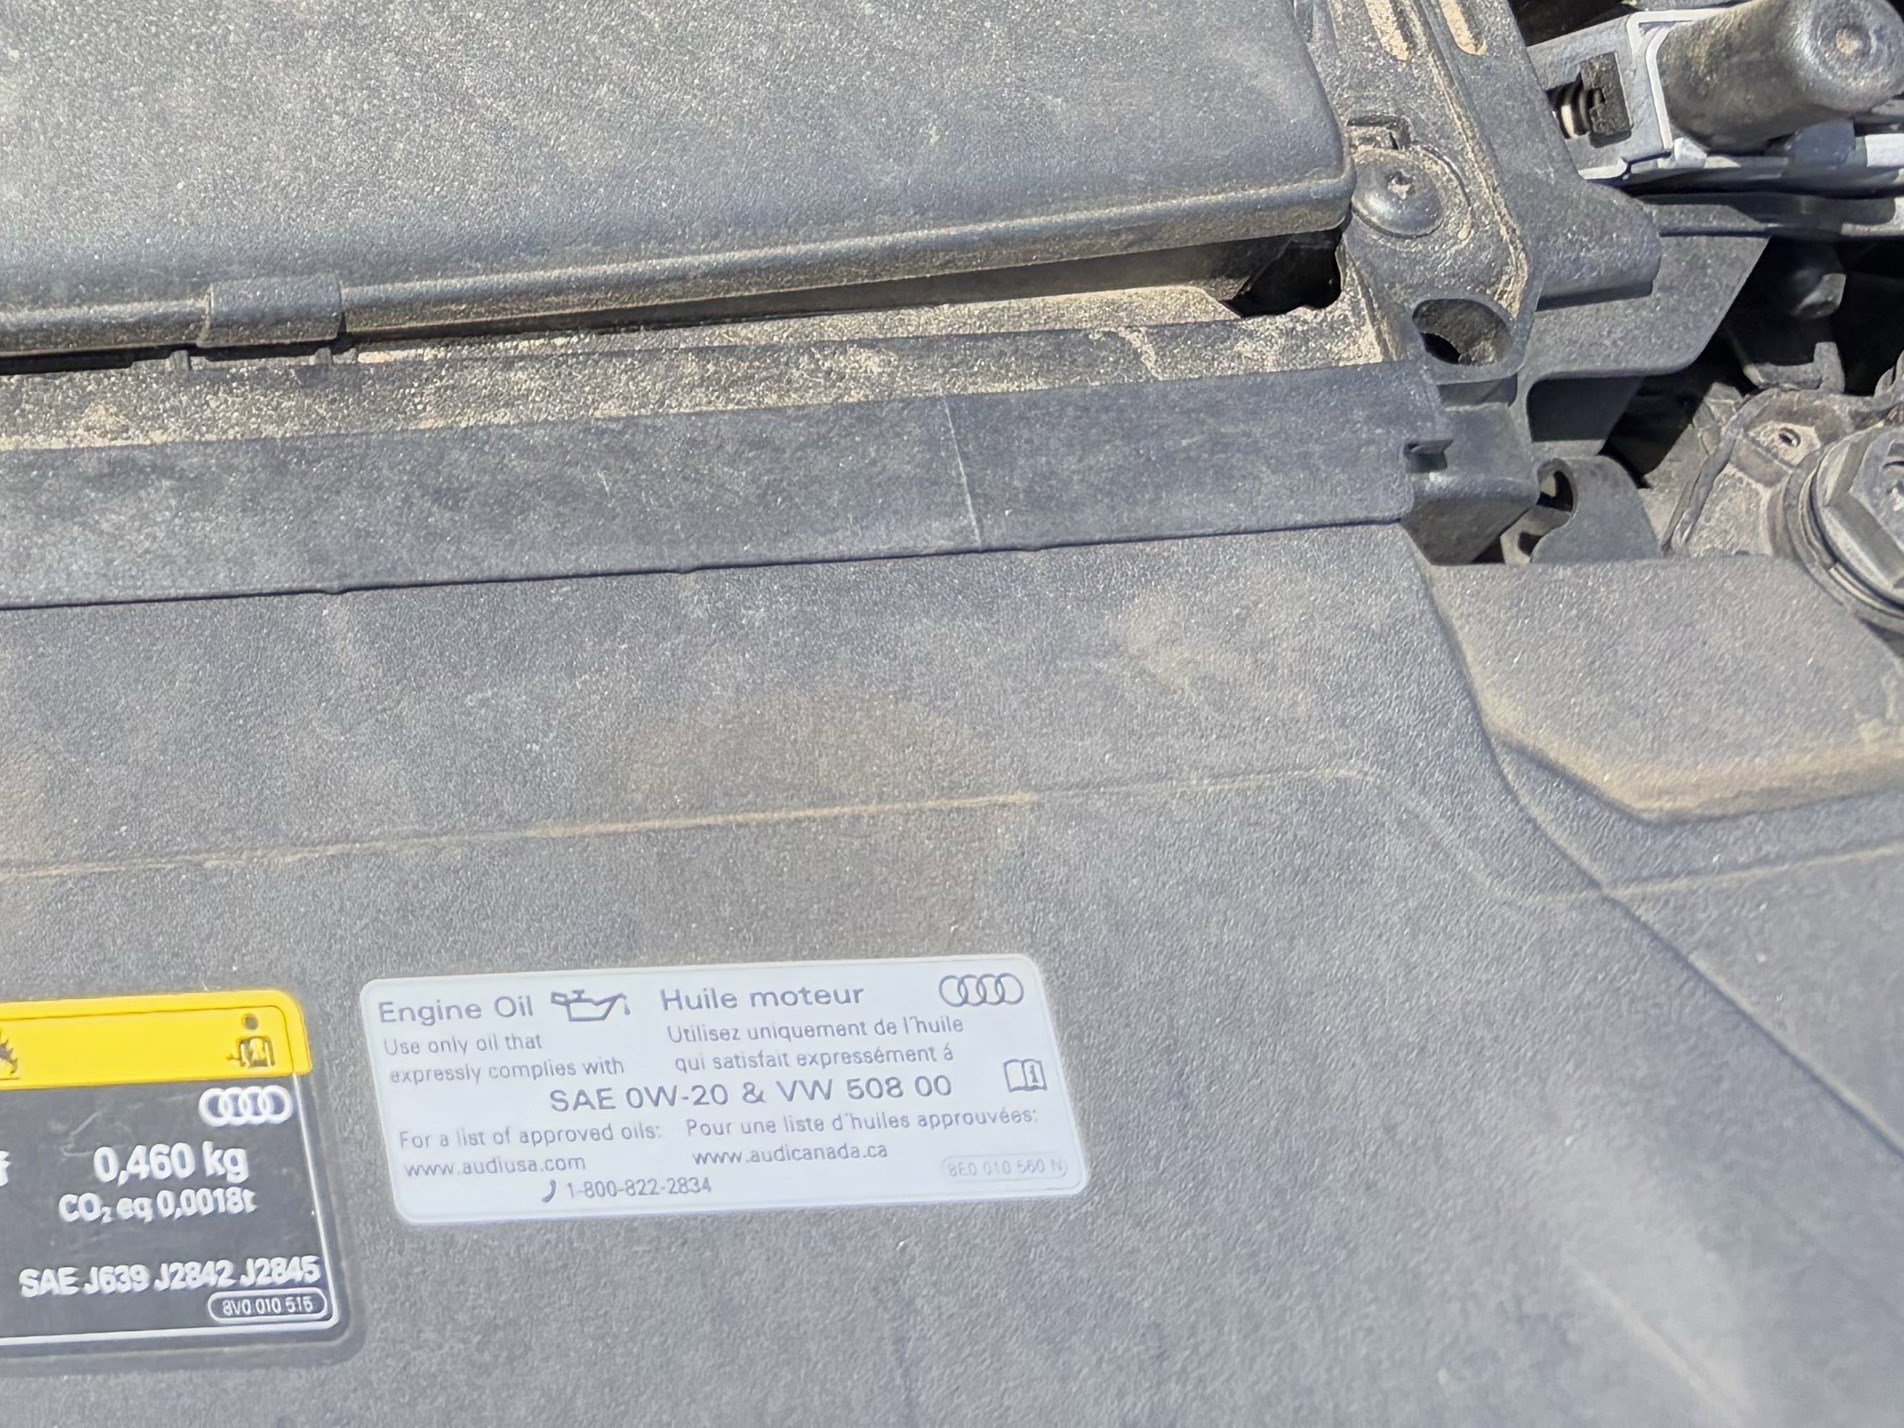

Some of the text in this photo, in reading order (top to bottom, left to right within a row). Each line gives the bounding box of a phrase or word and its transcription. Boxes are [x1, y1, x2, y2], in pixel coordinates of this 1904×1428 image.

[377, 993, 535, 1028] Engine Oil
[659, 985, 866, 1012] Huile moteur
[383, 1032, 544, 1057] Use only oil that
[667, 1015, 965, 1045] Utilisez uniquement de l'huile
[389, 1056, 626, 1087] expressly complies with
[674, 1053, 708, 1074] qui
[711, 1049, 791, 1071] satisfait
[795, 1045, 938, 1071] expressément
[548, 1074, 954, 1113] SAE 0W-20 & VW 508 00
[398, 1121, 662, 1150] For a list of approved oils:
[685, 1106, 1040, 1138] Pour une liste d'huiles approuvées:
[92, 1140, 250, 1187] 0,460 kg
[404, 1154, 588, 1179] www.audiusa.com
[691, 1142, 889, 1167] www.audicanada.ca
[948, 1161, 978, 1178] 8E0
[983, 1160, 1012, 1176] 010
[566, 1176, 713, 1199] 1-800-822-2834
[115, 1196, 154, 1225] eq
[155, 1185, 260, 1221] 0,0018t
[18, 1253, 322, 1299] SAE J639 J2842 J2845
[255, 1296, 282, 1315] 010
